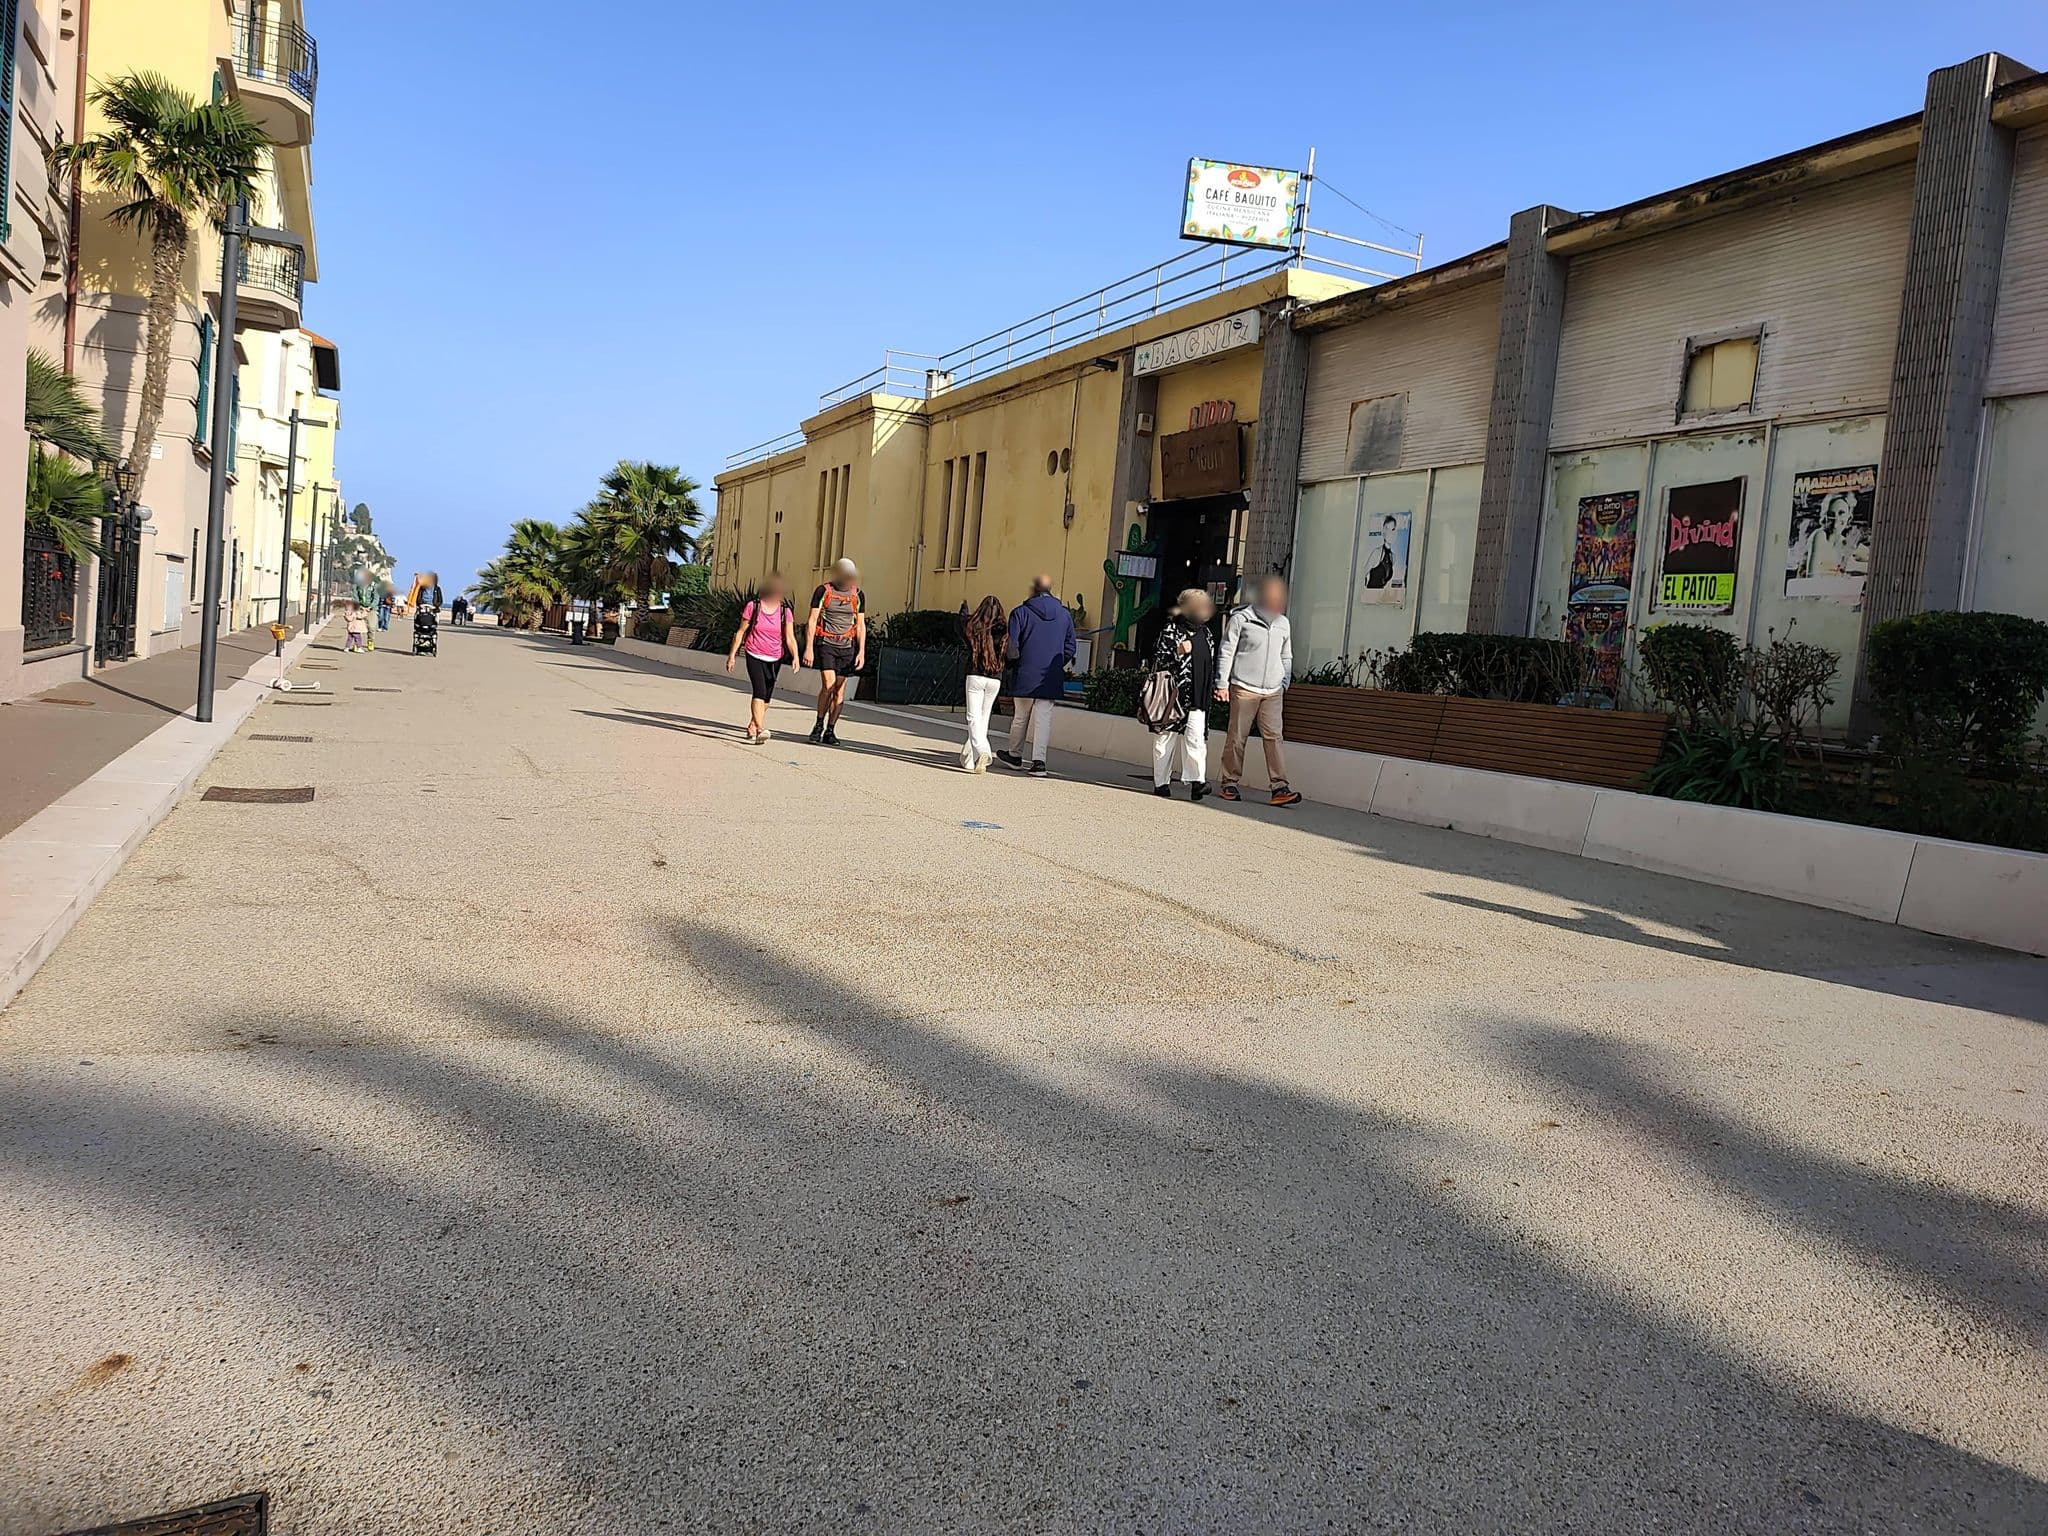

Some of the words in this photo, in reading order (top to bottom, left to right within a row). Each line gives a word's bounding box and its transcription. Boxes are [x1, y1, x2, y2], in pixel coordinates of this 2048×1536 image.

[1205, 187, 1231, 202] CAFÉ
[1235, 191, 1277, 208] BAQUITO
[1150, 319, 1233, 370] BAGNI
[1794, 468, 1876, 495] MARIANNA
[1663, 576, 1677, 601] EL
[1681, 575, 1717, 601] PATIO
